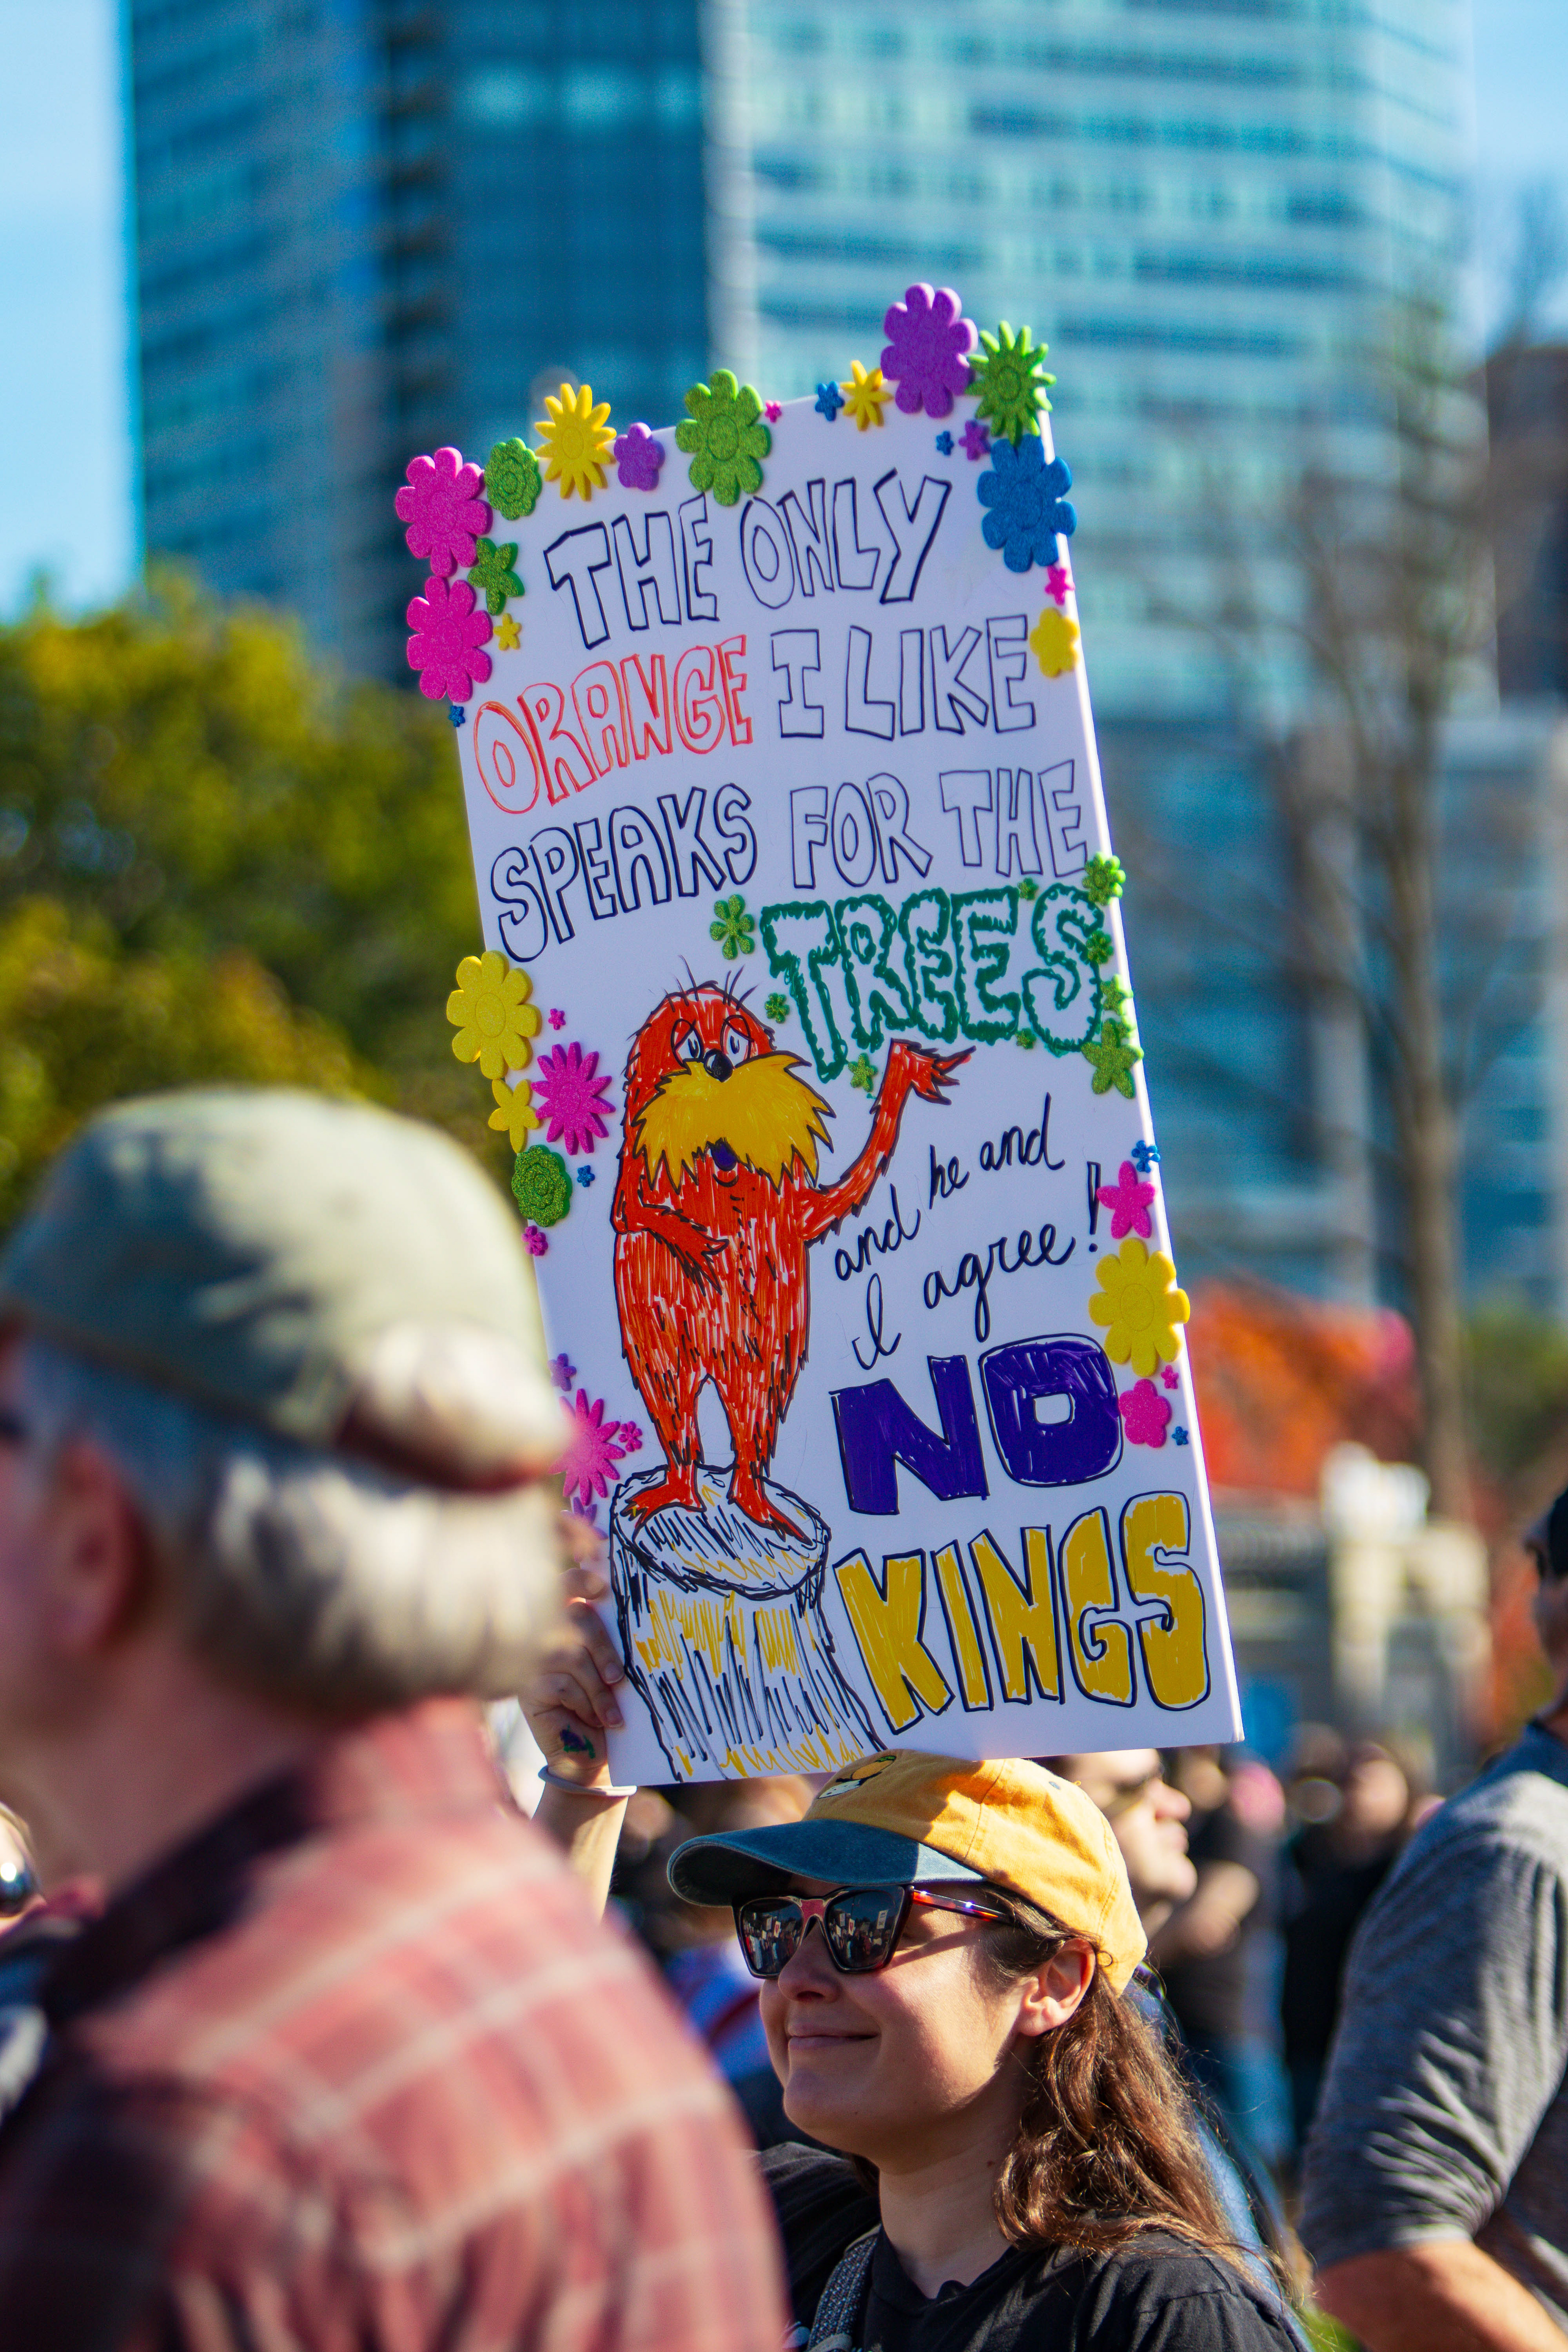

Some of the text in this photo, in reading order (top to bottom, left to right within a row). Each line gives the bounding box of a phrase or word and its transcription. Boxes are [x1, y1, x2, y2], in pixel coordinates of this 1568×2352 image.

[544, 468, 952, 649] THE ONLY
[474, 615, 1036, 814] ORANGE I LIKE
[490, 759, 1088, 963] SPEAKS FOR THE
[760, 882, 1105, 1082] TREES
[835, 1093, 1065, 1281] and he and
[829, 1332, 1124, 1515] NO
[833, 1491, 1212, 1735] KINGS
